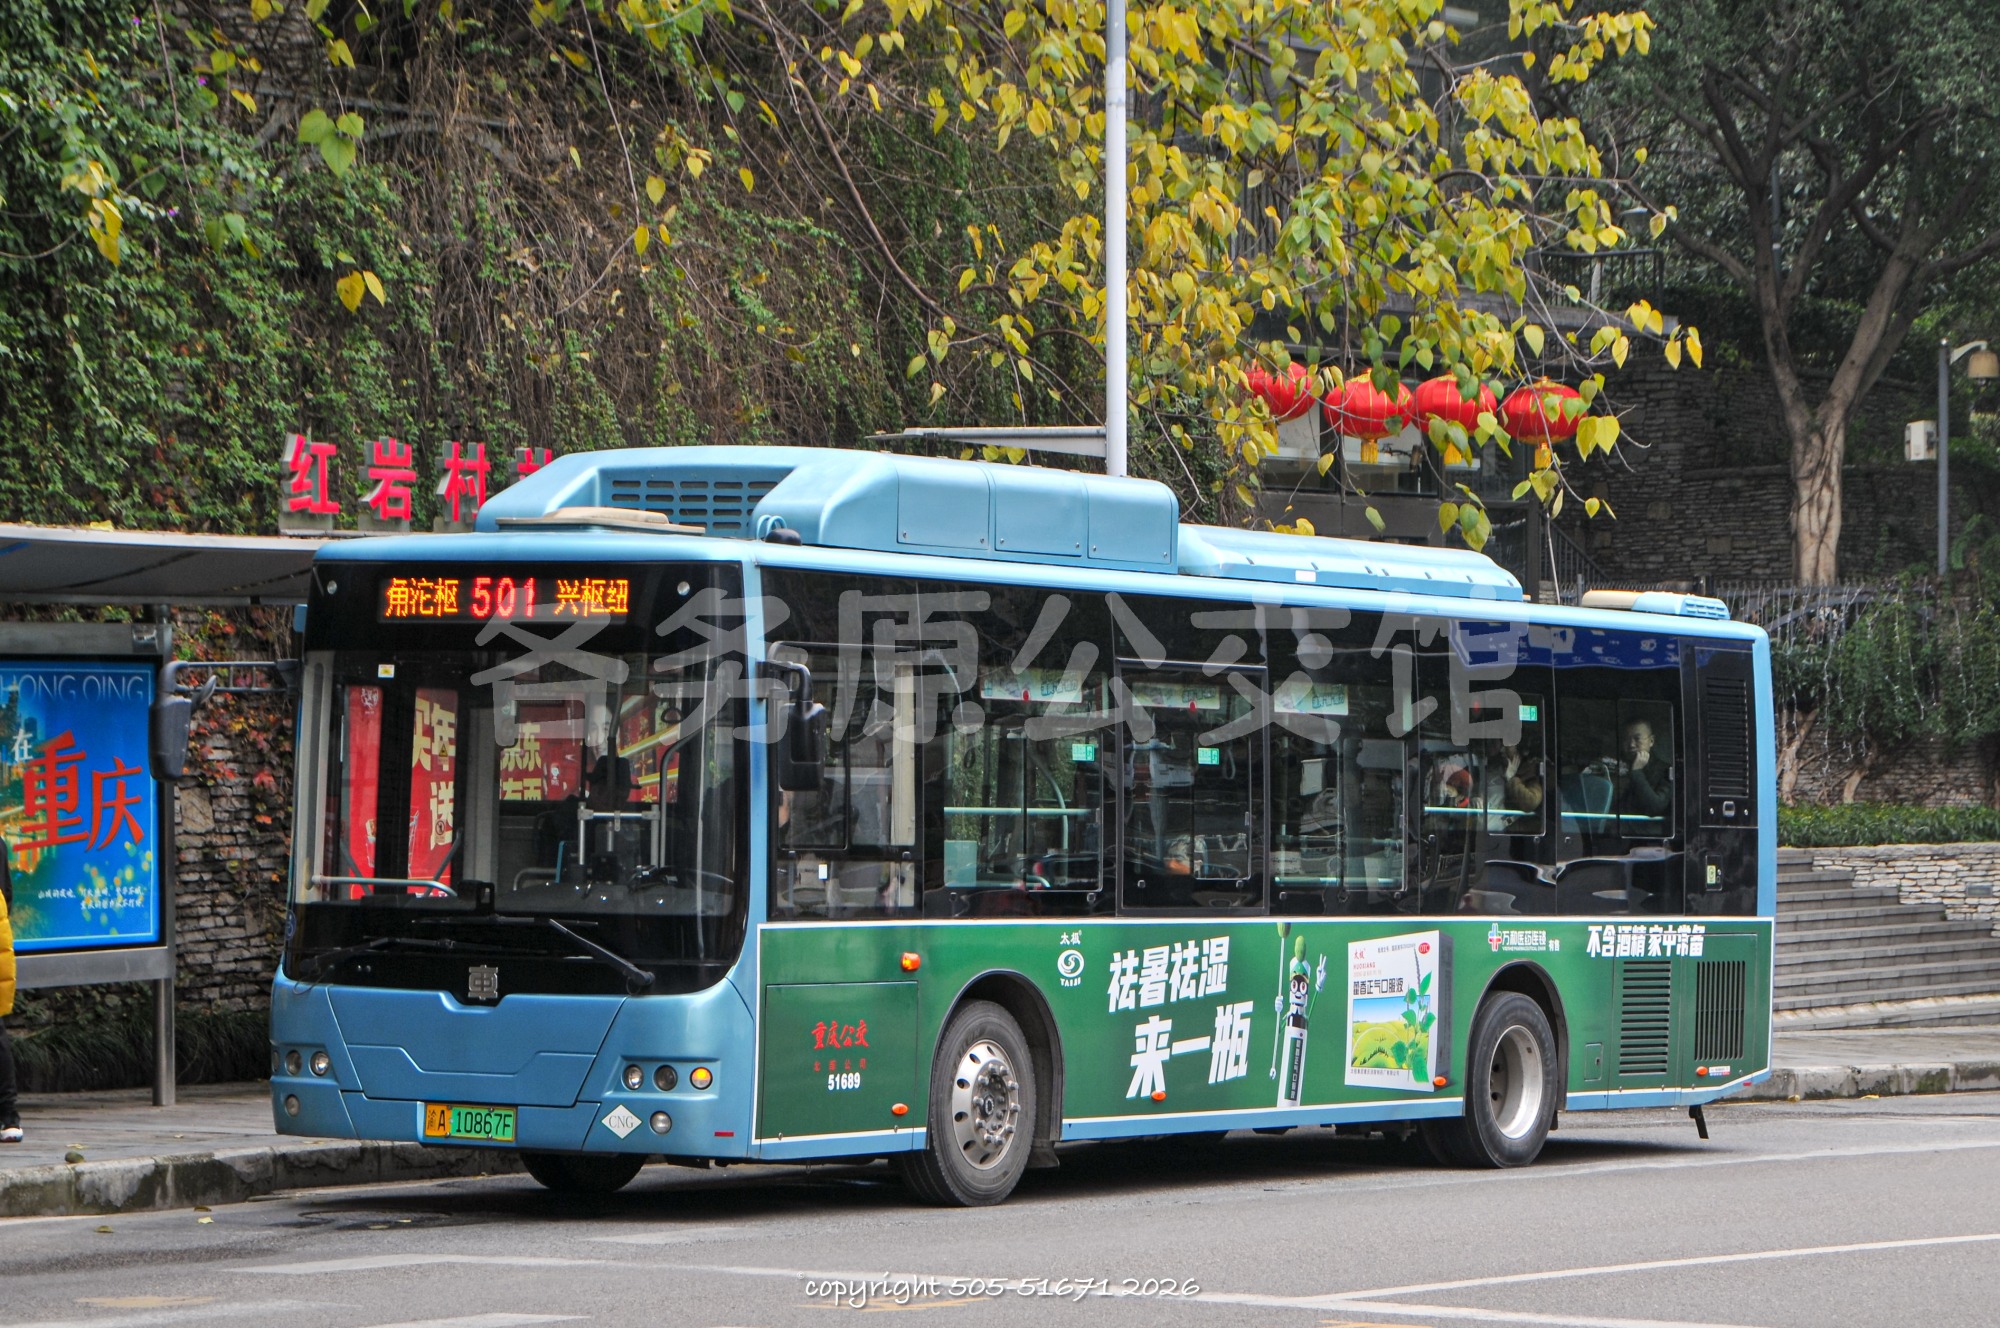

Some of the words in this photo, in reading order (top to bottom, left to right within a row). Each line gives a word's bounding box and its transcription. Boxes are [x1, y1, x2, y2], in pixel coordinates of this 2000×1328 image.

[288, 434, 552, 522] 红岩村
[386, 577, 459, 617] 角沱枢
[470, 577, 536, 617] 501
[554, 577, 629, 617] 兴枢纽
[11, 727, 34, 762] 在
[12, 729, 145, 852] 重庆
[1107, 935, 1230, 1013] 祛暑祛湿
[811, 1019, 870, 1050] 重庆公交
[1125, 1001, 1254, 1099] 来一瓶
[827, 1072, 861, 1091] 51689
[456, 1110, 513, 1136] 10867F
[608, 1115, 634, 1128] CNG
